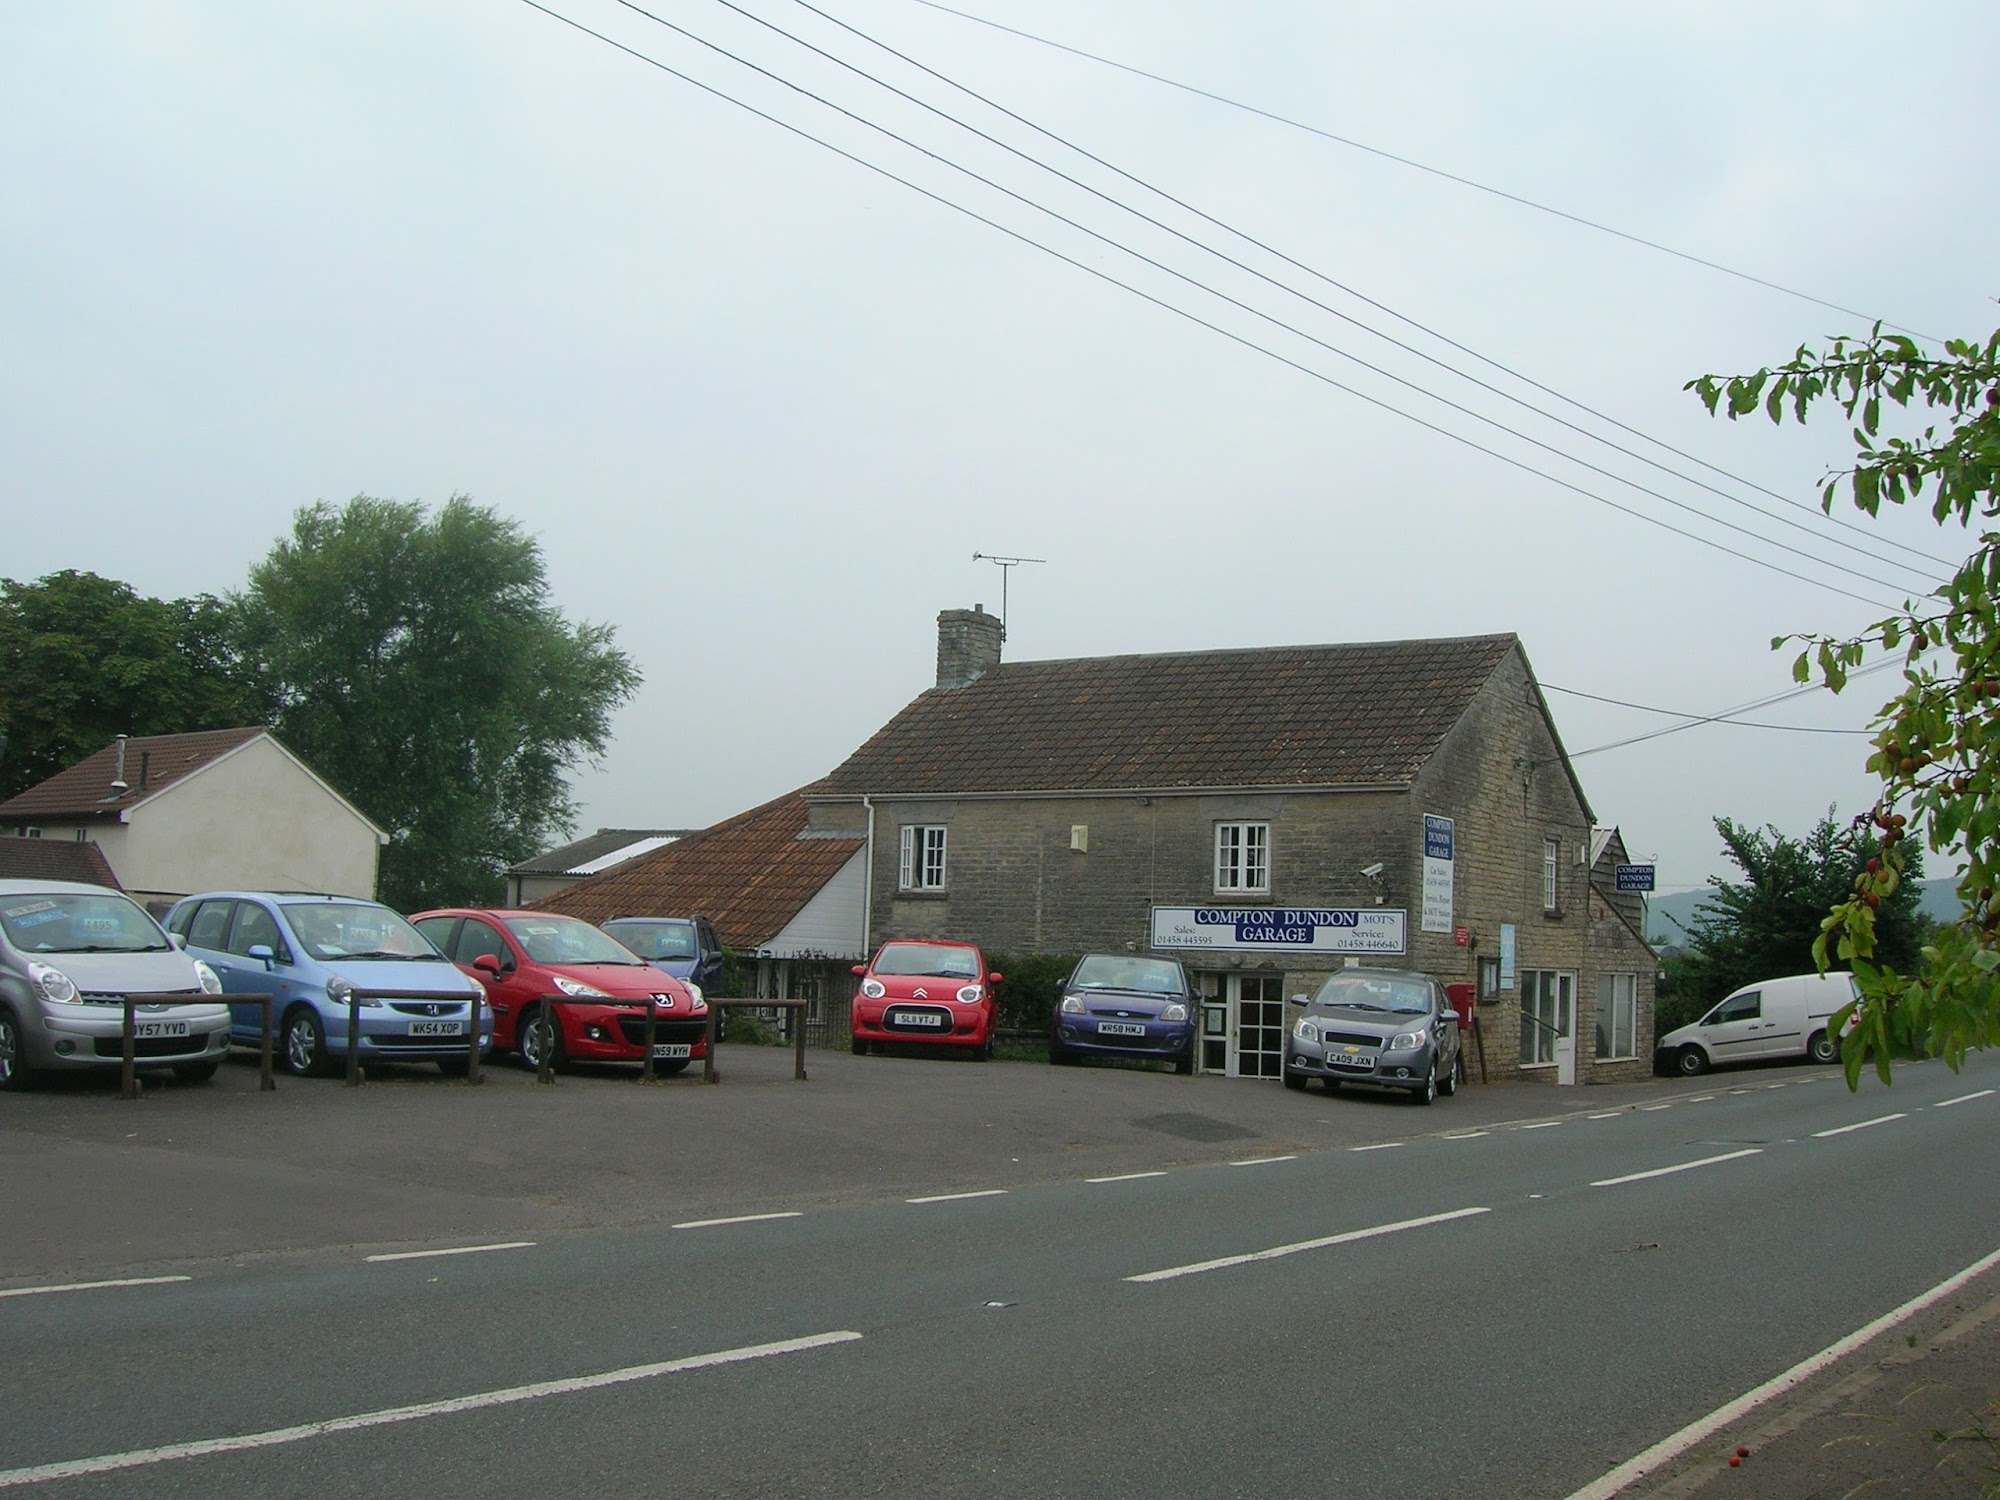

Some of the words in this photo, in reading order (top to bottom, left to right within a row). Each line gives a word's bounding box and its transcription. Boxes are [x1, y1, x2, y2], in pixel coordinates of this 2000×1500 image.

[1427, 817, 1451, 830] COMPTON
[1428, 831, 1450, 844] DUNDON
[1429, 845, 1449, 858] GARAGE
[1617, 866, 1654, 874] COMPTON
[1620, 874, 1652, 882] DUNDON
[1620, 882, 1651, 890] GARAGE
[1197, 910, 1275, 924] COMPTON
[1284, 911, 1355, 926] DUNDON
[1363, 915, 1395, 924] MOT'S
[1174, 925, 1196, 934] Sales:
[1242, 927, 1307, 942] GARAGE
[1351, 929, 1384, 938] Service:
[1156, 935, 1181, 944] 01458
[1184, 936, 1213, 945] 445595
[1337, 940, 1363, 948] 01458
[1366, 940, 1399, 949] 446640
[918, 1015, 935, 1025] VTJ
[164, 1023, 186, 1035] YVD
[413, 1023, 438, 1034] WK54
[440, 1023, 459, 1034] XOP
[1101, 1024, 1124, 1033] WR58
[672, 1046, 689, 1056] WYH
[1329, 1053, 1352, 1064] CA09
[1354, 1056, 1372, 1066] JXN
